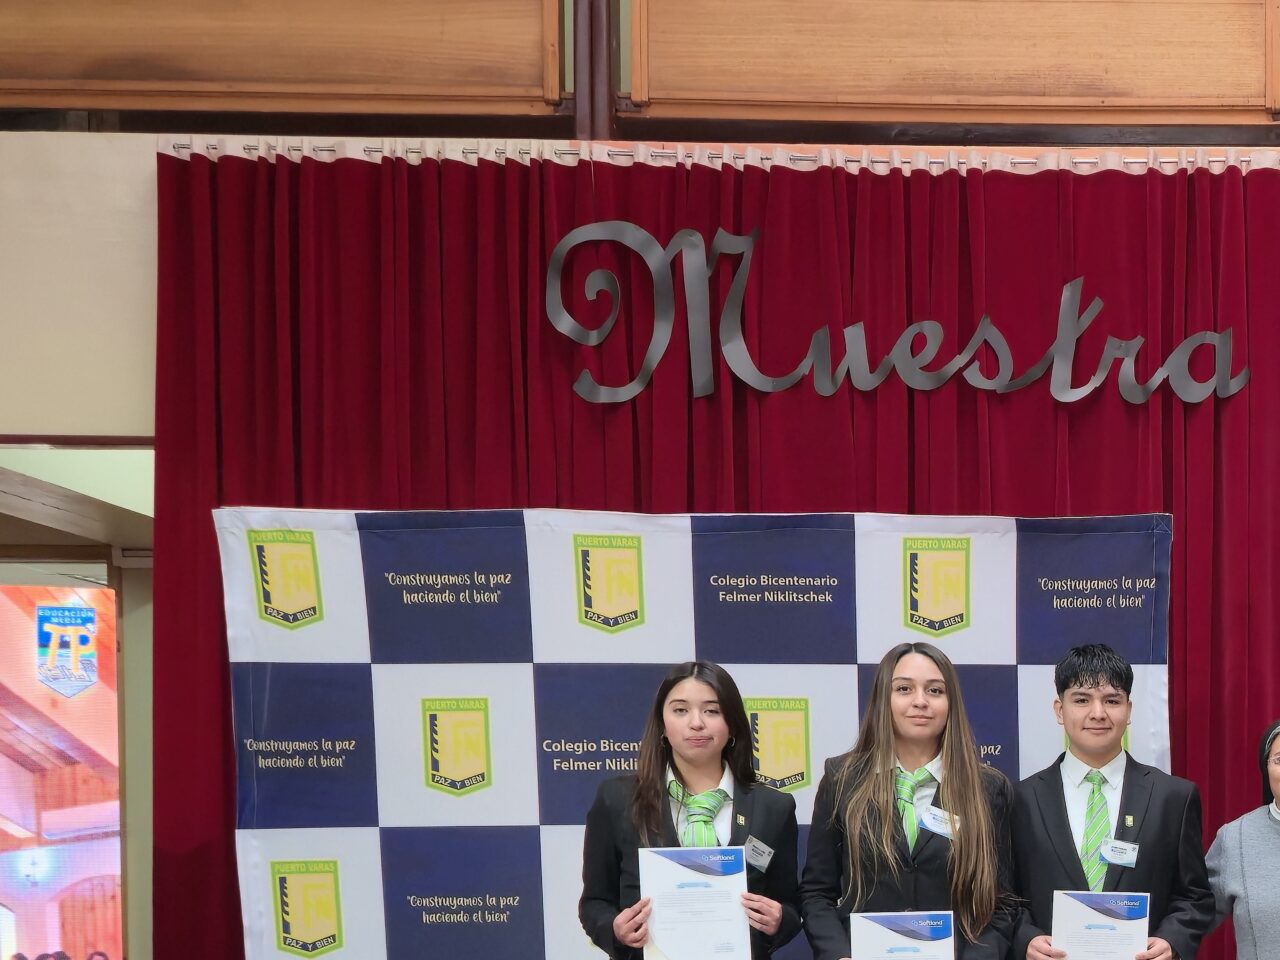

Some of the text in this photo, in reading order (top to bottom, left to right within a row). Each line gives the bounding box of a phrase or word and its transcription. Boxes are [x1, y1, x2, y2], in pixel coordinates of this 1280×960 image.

[546, 220, 1251, 404] Muestra
[906, 540, 967, 549] PUERTO VARAS
[475, 571, 486, 585] la
[490, 573, 512, 587] paz
[710, 574, 838, 588] Colegio Bicentenario
[1122, 576, 1132, 589] la
[1136, 578, 1156, 591] paz
[403, 590, 455, 604] haciendo
[459, 590, 470, 604] el
[719, 591, 833, 603] Felmer Niklitschek
[1052, 595, 1102, 609] haciendo
[1106, 594, 1116, 608] el
[912, 615, 930, 627] PAZ
[943, 616, 962, 627] BIEN
[425, 700, 486, 709] PUERTO VARAS
[322, 738, 332, 750] la
[336, 739, 356, 752] paz
[542, 739, 597, 753] Colegio
[980, 744, 1001, 758] paz
[258, 755, 304, 768] haciendo
[308, 755, 317, 768] el
[553, 759, 602, 770] Felmer
[434, 775, 451, 786] PAZ
[464, 775, 482, 786] BIEN
[487, 894, 497, 906] la
[500, 896, 519, 907] paz
[422, 910, 469, 924] haciendo
[473, 910, 482, 922] el
